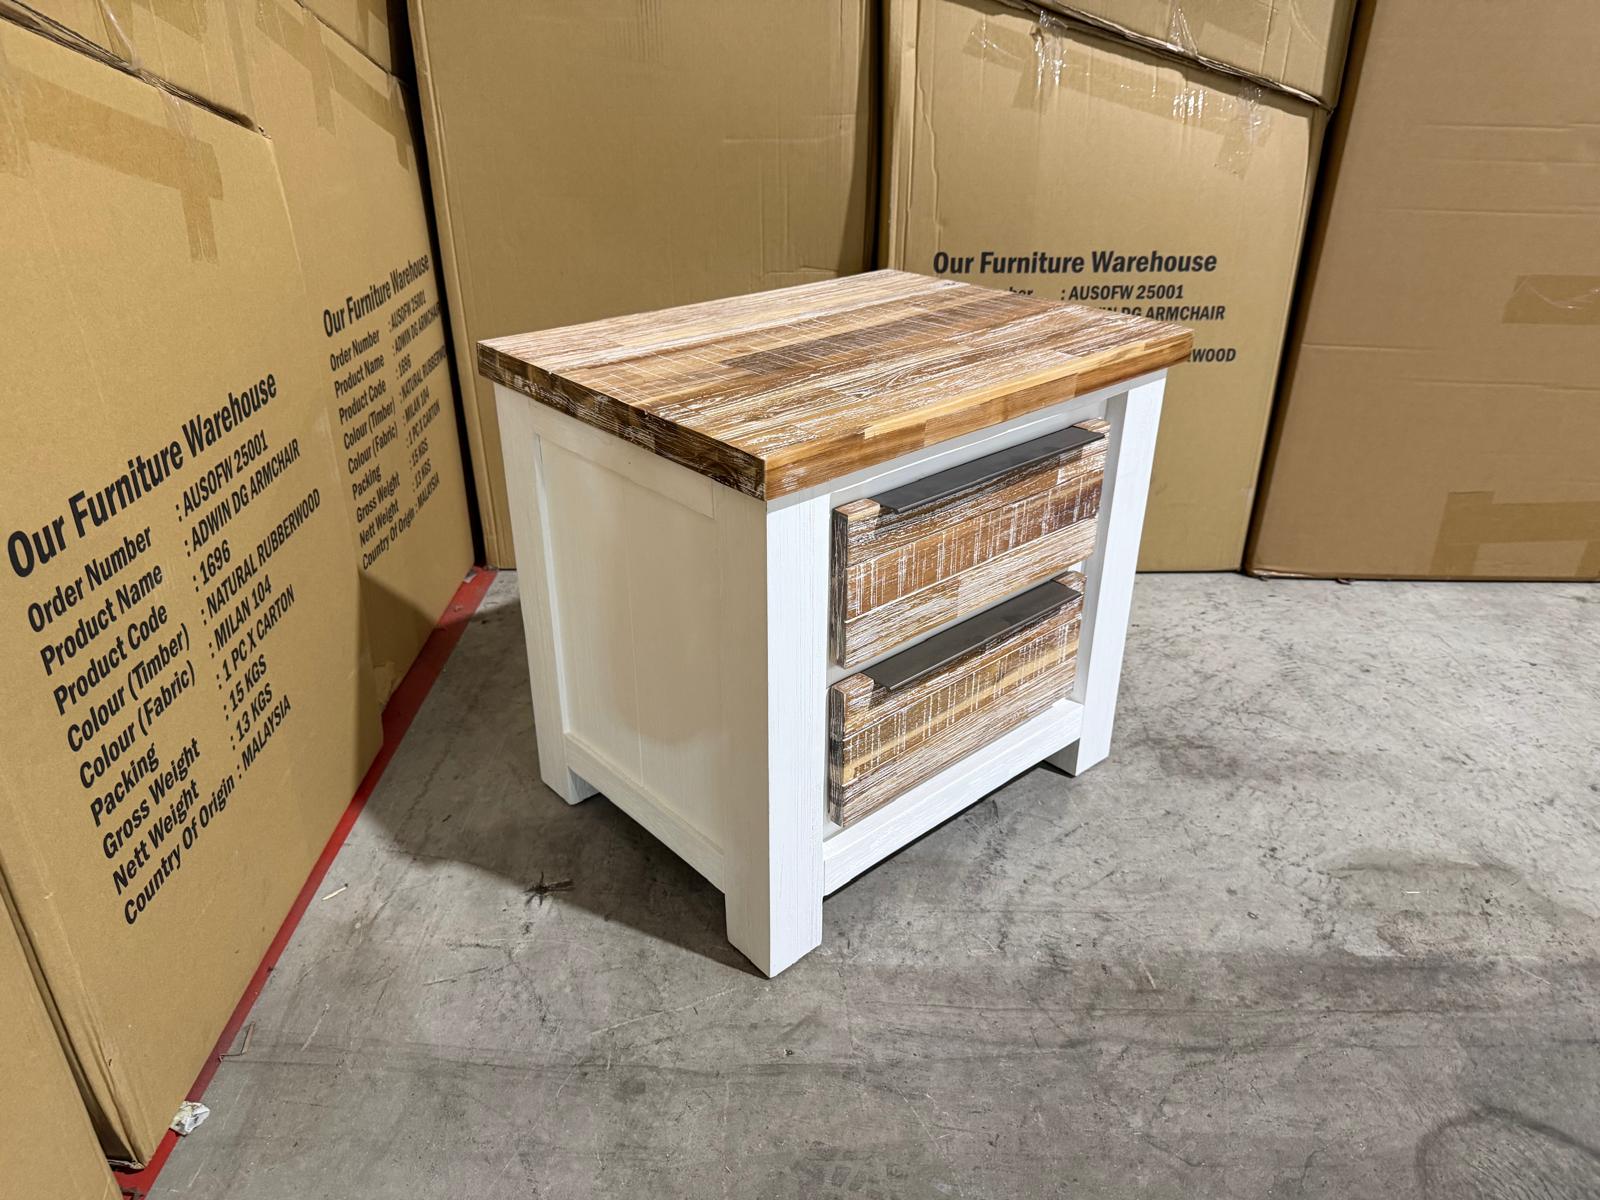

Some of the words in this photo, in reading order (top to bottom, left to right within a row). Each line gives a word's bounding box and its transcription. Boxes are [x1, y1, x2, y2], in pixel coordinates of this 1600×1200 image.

[323, 307, 345, 338] Our
[345, 282, 391, 324] Furniture
[389, 254, 429, 295] Warehouse
[933, 251, 974, 273] Our
[979, 252, 1085, 273] Furniture
[1091, 251, 1217, 273] Warehouse
[1068, 285, 1134, 300] AUSOFW
[1136, 284, 1184, 300] 25001
[1145, 305, 1226, 321] ARMCHAIR
[1187, 348, 1237, 363] WOOD
[7, 515, 67, 578] Our
[68, 441, 183, 538] Furniture
[181, 373, 277, 458] Warehouse
[27, 576, 84, 633] Order
[84, 526, 151, 592] Number
[183, 455, 233, 518] AUSOFW
[233, 429, 269, 474] 25001
[40, 597, 117, 677] Product
[115, 565, 163, 615] Name
[191, 498, 232, 552] ADWIN
[231, 484, 250, 515] DG
[250, 438, 301, 500] ARMCHAIR
[53, 635, 128, 717] Product
[127, 605, 168, 650] Code
[199, 539, 231, 586] 1696
[67, 685, 126, 752] Colour
[127, 622, 190, 701] (Timber)
[206, 553, 258, 619] NATURAL
[256, 488, 320, 567] RUBBERWOOD
[79, 721, 136, 789] Colour
[137, 659, 195, 737] (Fabric)
[213, 596, 251, 652] MILAN
[251, 574, 272, 610] 104
[90, 742, 159, 828] Packing
[222, 658, 232, 682] 1
[230, 638, 248, 672] PC
[246, 627, 257, 654] X
[256, 584, 295, 641] CARTON
[103, 798, 150, 859] Gross
[148, 737, 200, 806] Weight
[229, 680, 245, 712] 15
[244, 654, 267, 693] KGS
[112, 839, 151, 896] Nett
[147, 779, 200, 850] Weight
[236, 710, 251, 742] 13
[250, 682, 273, 723] KGS
[124, 843, 181, 925] Country
[182, 816, 198, 850] Of
[199, 774, 235, 828] Origin
[241, 694, 291, 772] MALAYSIA
